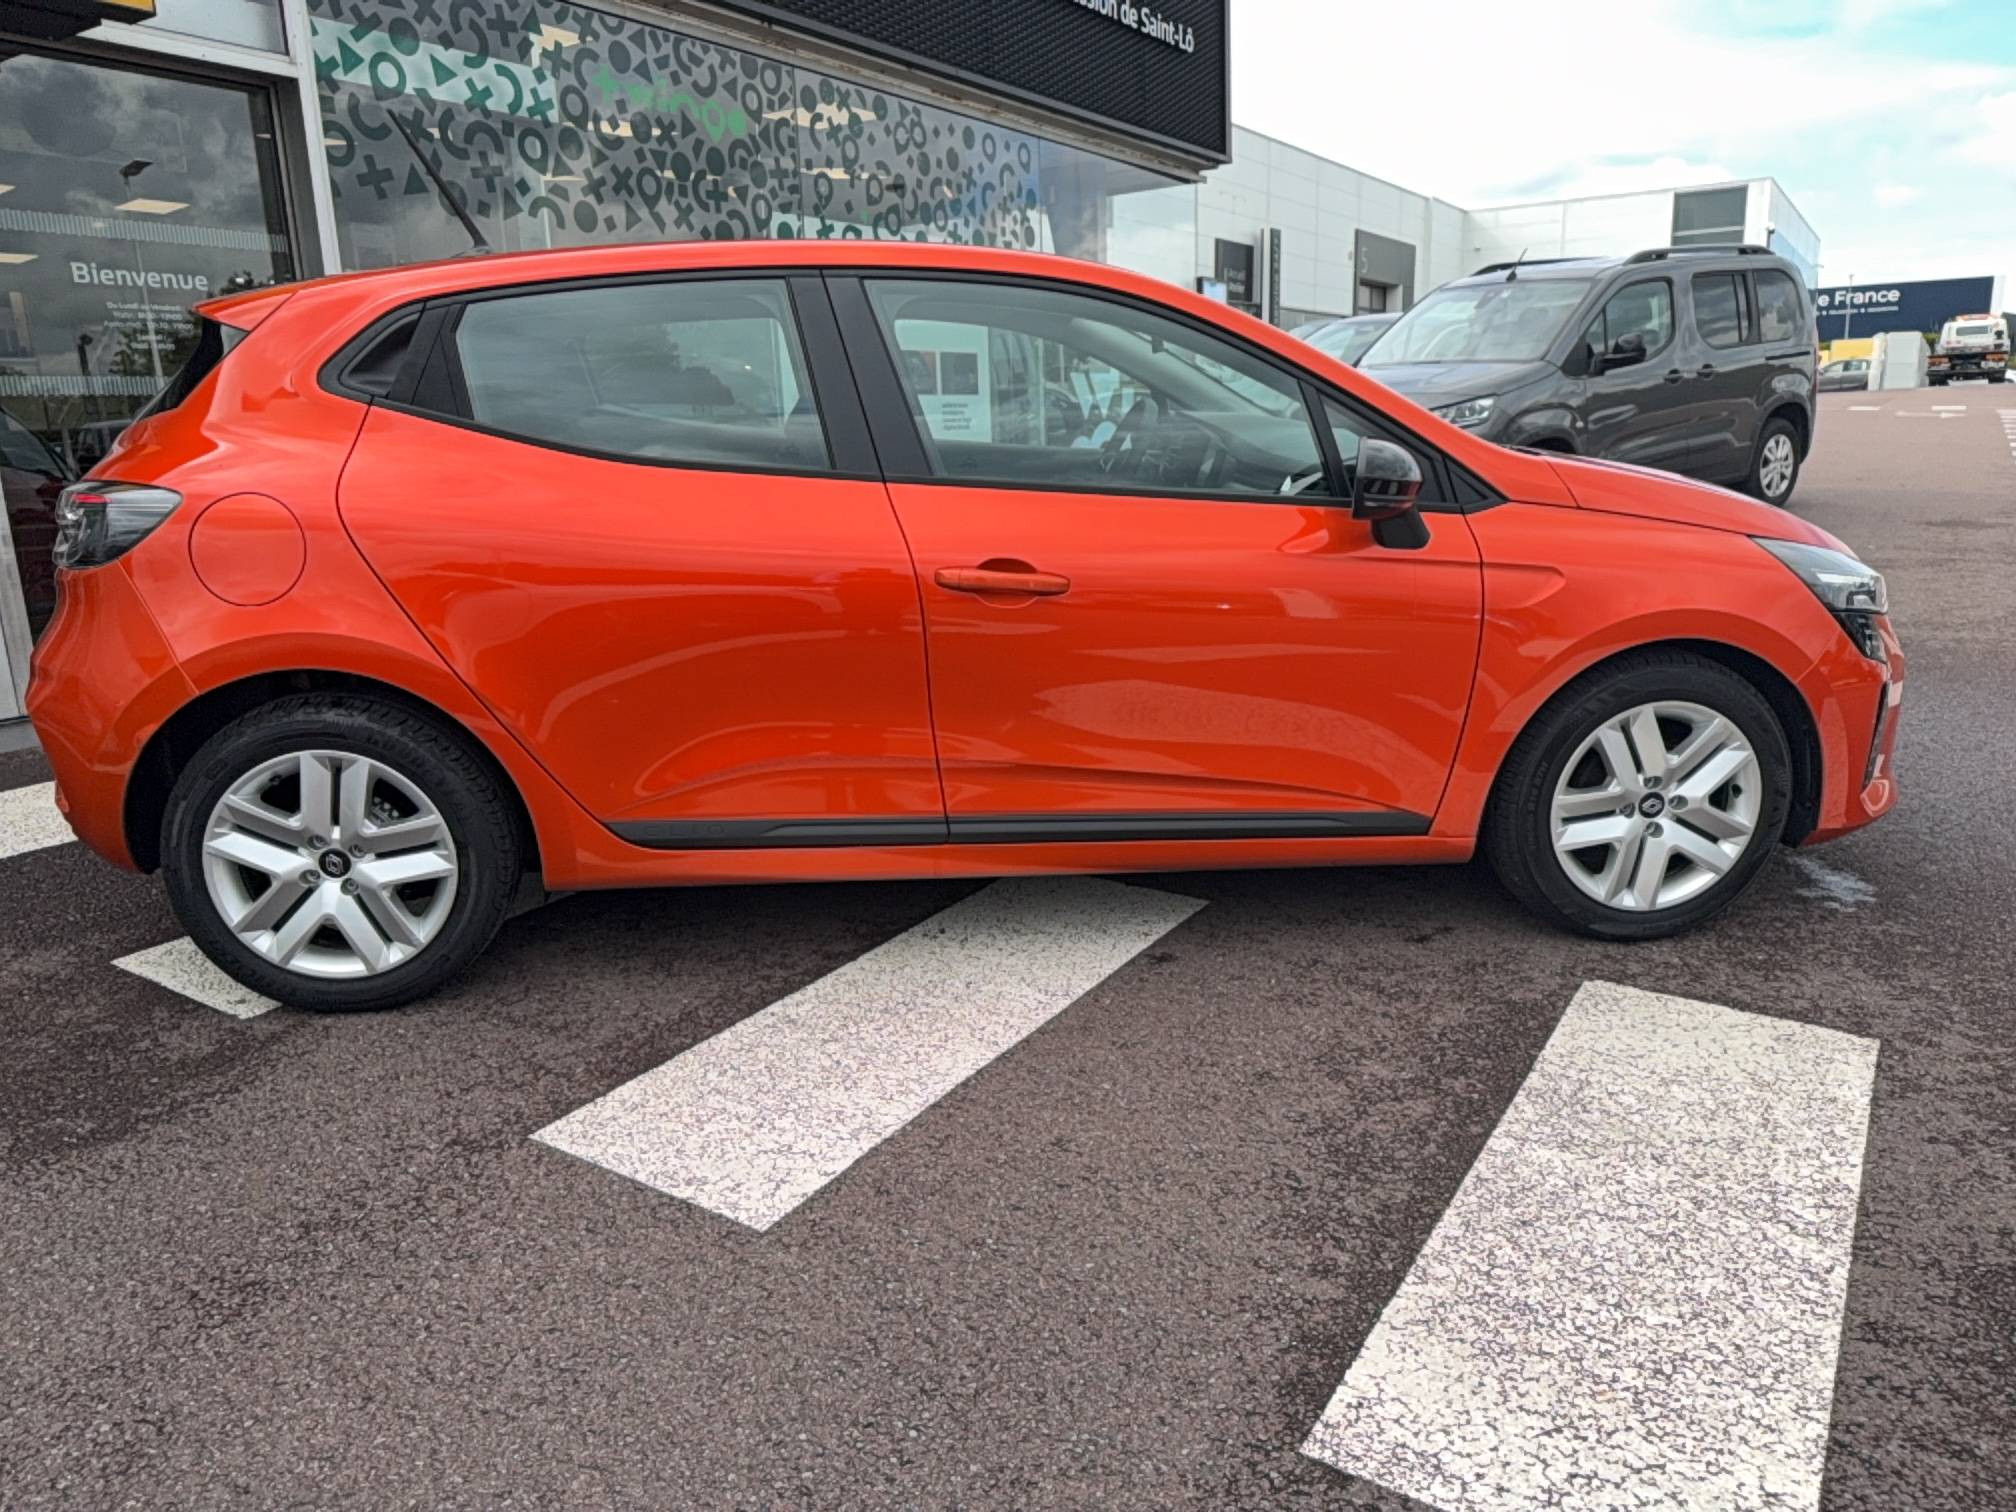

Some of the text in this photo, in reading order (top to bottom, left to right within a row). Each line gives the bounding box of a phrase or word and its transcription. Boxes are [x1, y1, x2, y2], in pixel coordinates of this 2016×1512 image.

[1120, 0, 1139, 29] de
[1140, 7, 1195, 53] Saint-Lô
[70, 261, 209, 291] Bienvenue
[1834, 289, 1901, 306] France
